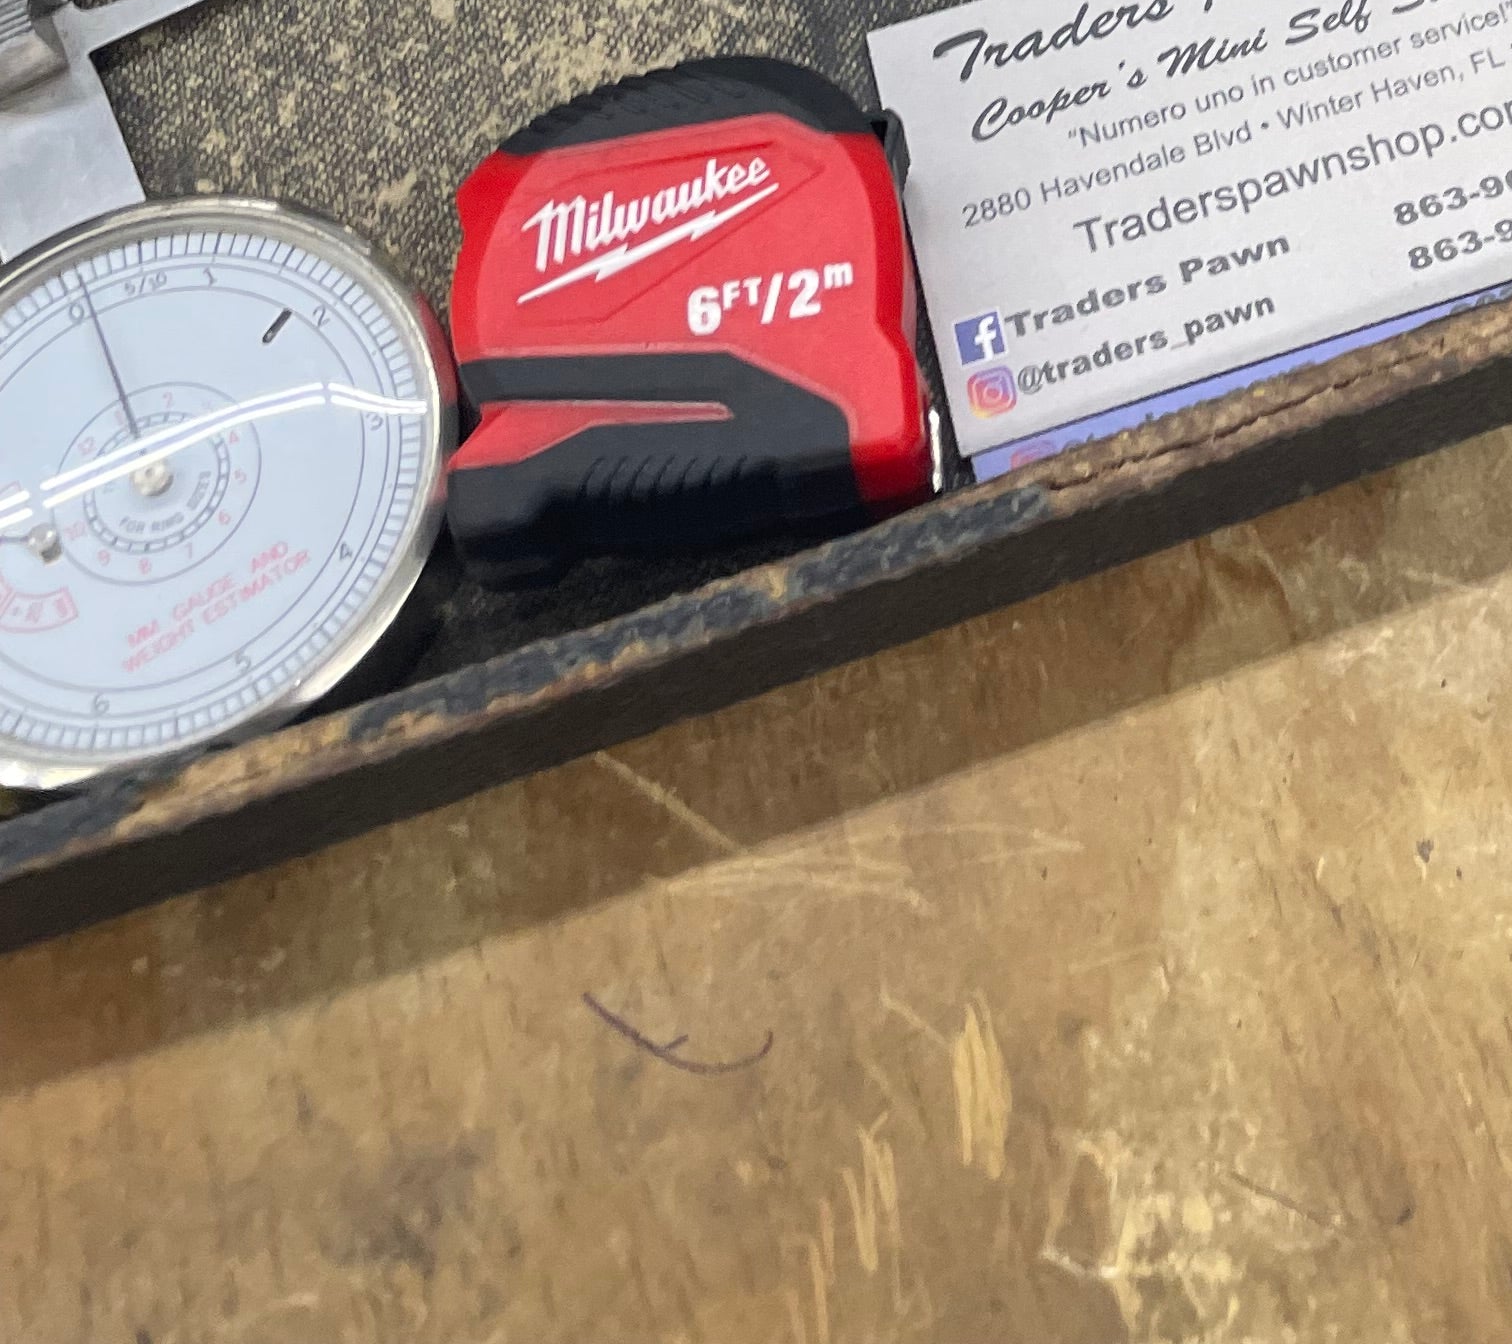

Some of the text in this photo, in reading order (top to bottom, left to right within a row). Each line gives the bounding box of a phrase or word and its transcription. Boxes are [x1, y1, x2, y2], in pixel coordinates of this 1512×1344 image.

[971, 60, 1149, 143] Cooper's
[1157, 28, 1269, 78] Mini
[1195, 84, 1245, 115] uno
[1251, 73, 1276, 98] in
[1283, 36, 1401, 88] customer
[962, 187, 1032, 230] 2880
[1039, 144, 1187, 204] Havendale
[1193, 121, 1253, 158] Blvd
[1276, 89, 1363, 131] Winter
[1371, 64, 1466, 105] Haven,
[1470, 47, 1507, 76] FL
[521, 157, 771, 272] Milwaukee
[312, 304, 330, 328] 2
[1004, 274, 1168, 337] Traders
[1179, 234, 1291, 286] Pawn
[1017, 295, 1276, 395] @traders_pawn
[368, 410, 385, 432] 3
